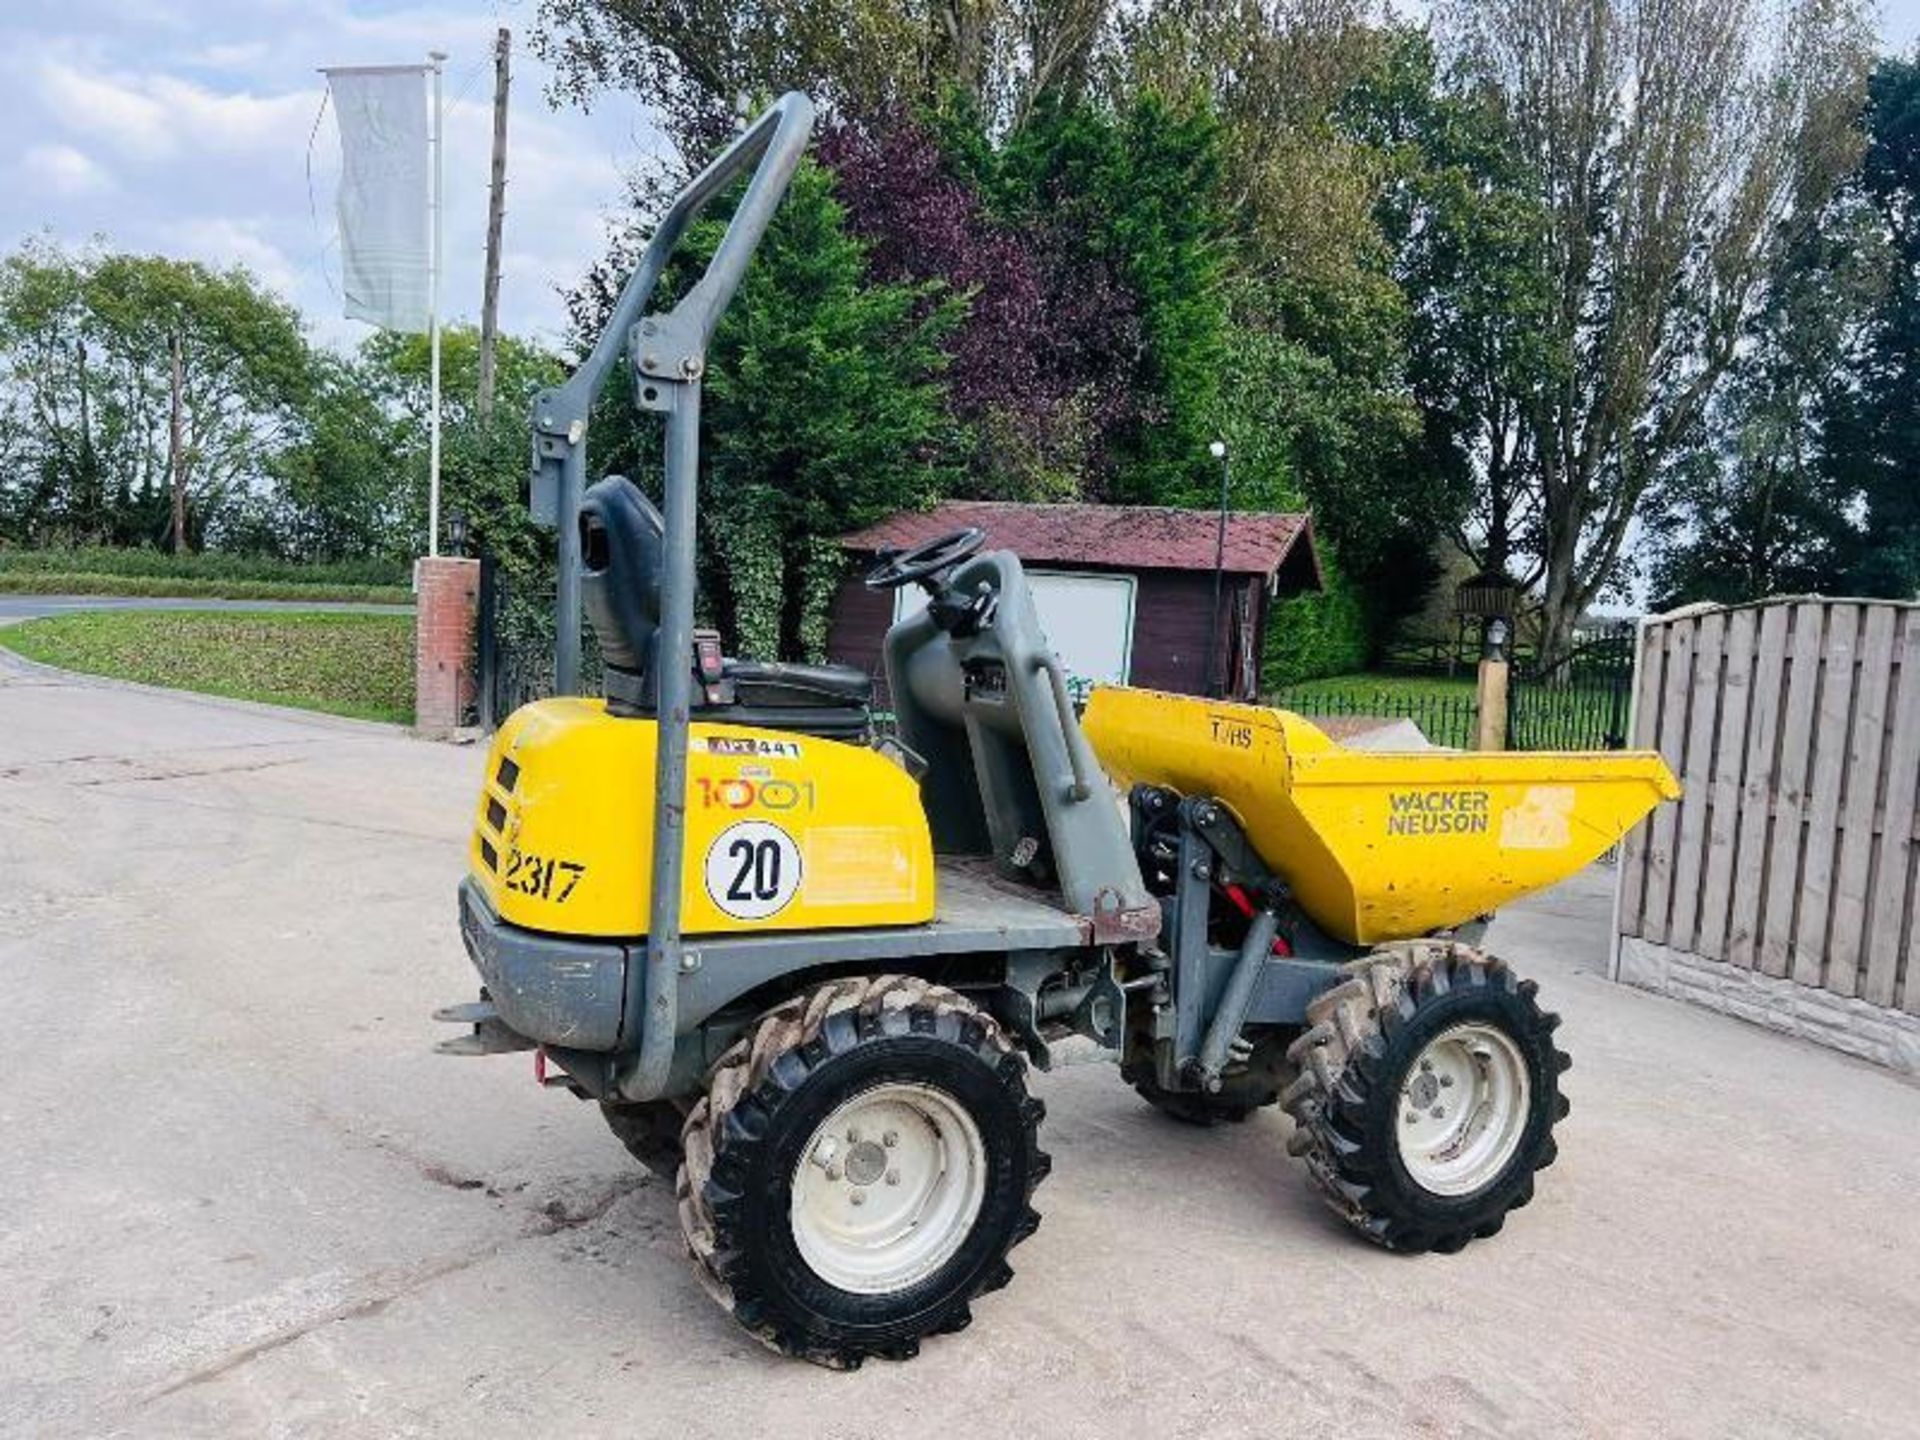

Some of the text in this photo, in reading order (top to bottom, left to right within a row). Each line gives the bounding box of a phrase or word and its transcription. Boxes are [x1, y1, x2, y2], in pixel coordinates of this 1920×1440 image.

[697, 778, 815, 811] 1001
[1389, 791, 1489, 812] WACKER
[1388, 813, 1488, 836] NEUSON
[506, 848, 586, 903] 2317
[727, 839, 781, 900] 20
